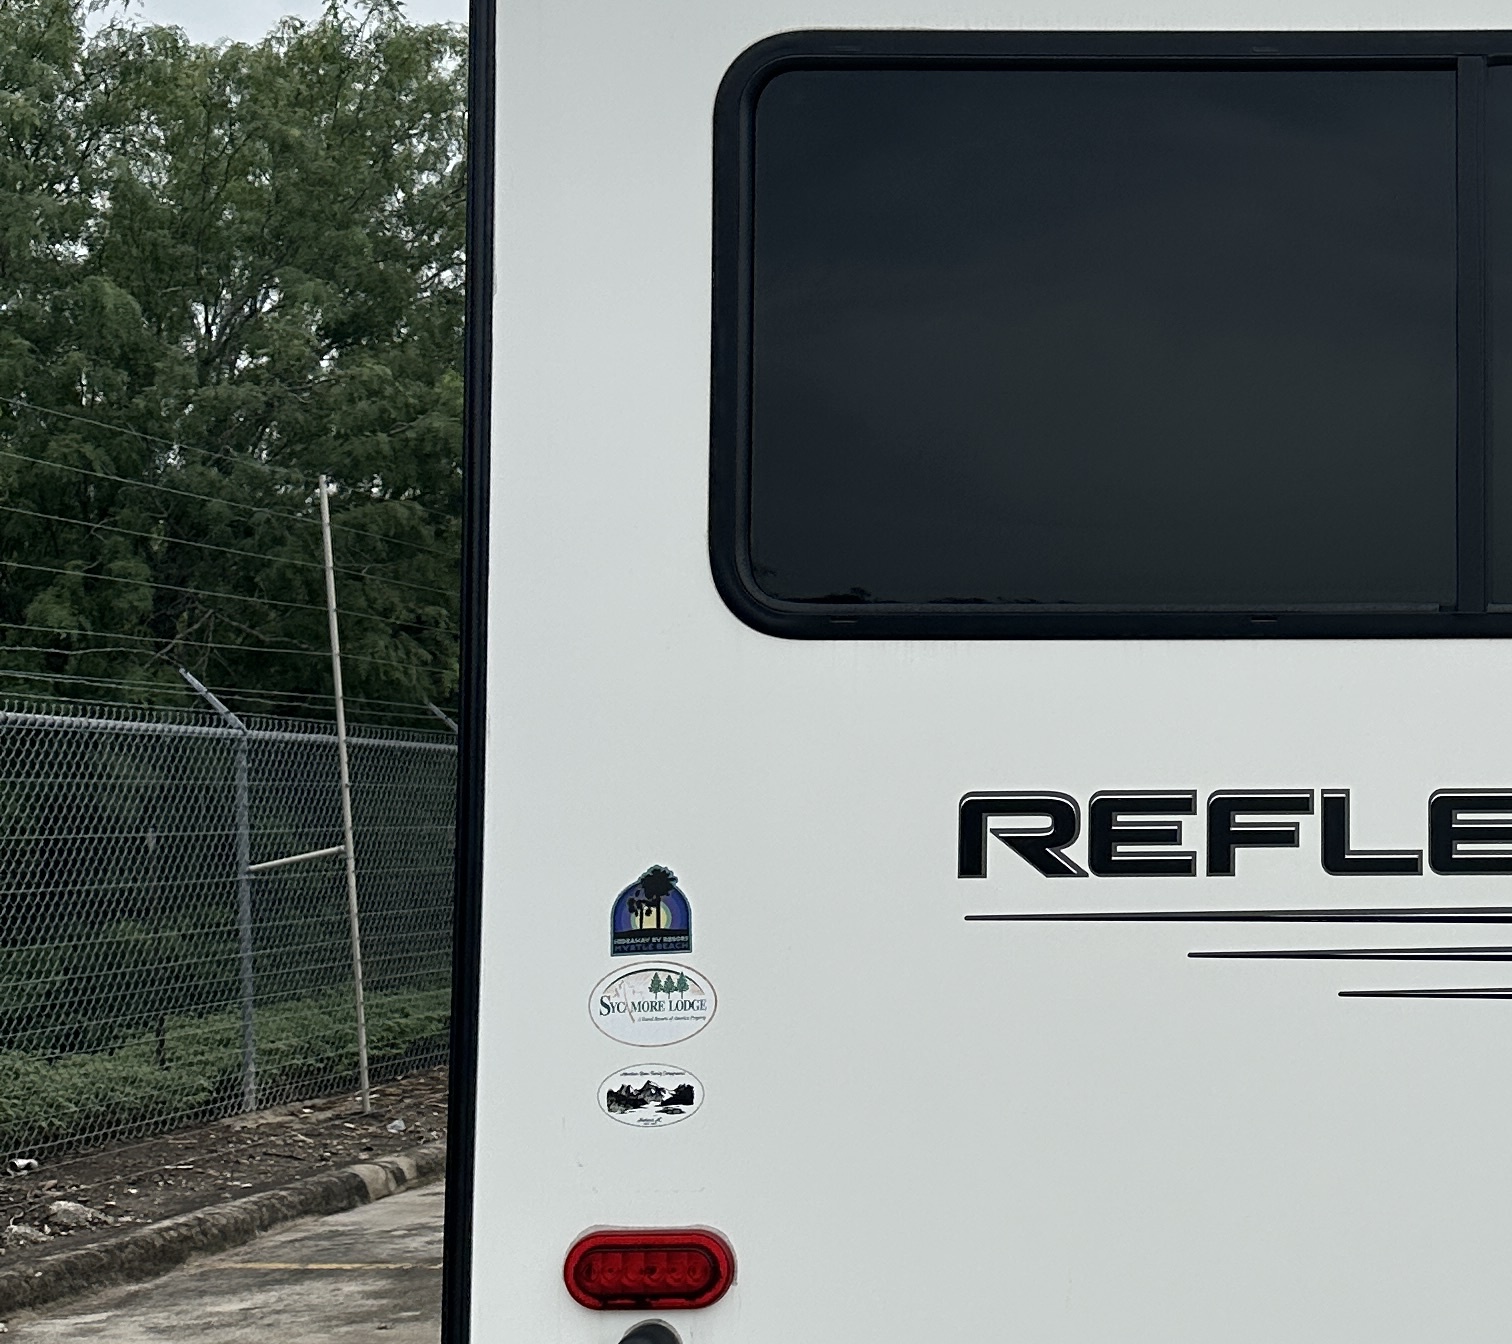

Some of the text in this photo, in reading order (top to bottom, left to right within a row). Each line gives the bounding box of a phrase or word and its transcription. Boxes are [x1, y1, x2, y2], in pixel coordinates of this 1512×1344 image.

[614, 941, 689, 952] MYRTLE BEACH
[668, 998, 707, 1012] LODGE
